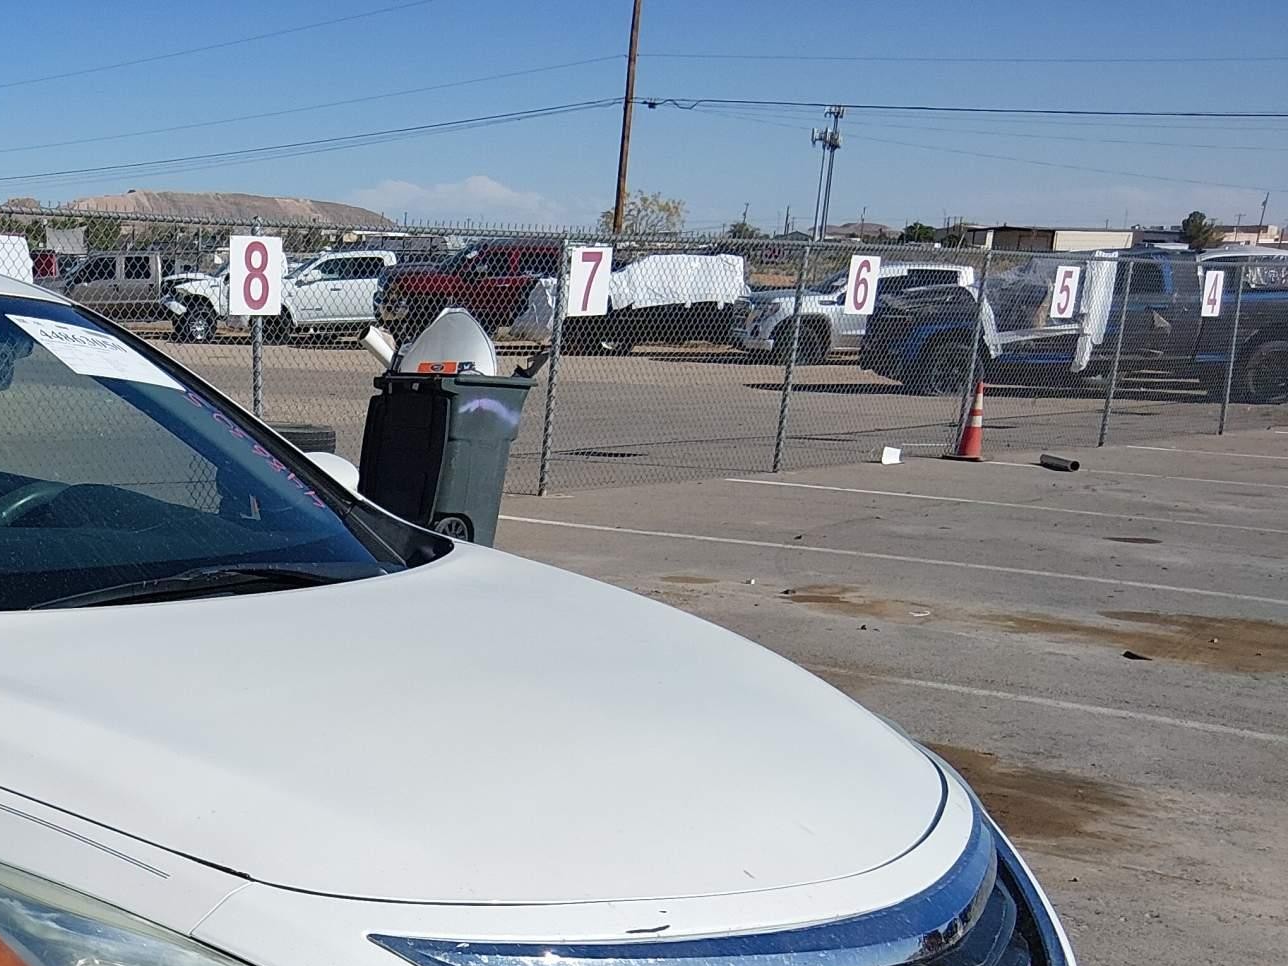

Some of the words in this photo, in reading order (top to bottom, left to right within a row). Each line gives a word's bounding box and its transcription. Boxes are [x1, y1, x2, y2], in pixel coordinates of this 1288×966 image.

[243, 241, 269, 310] 8
[580, 251, 604, 312] 7
[853, 259, 872, 311] 6
[1056, 270, 1075, 315] 5
[1206, 273, 1220, 314] 4
[39, 328, 128, 353] 44863050
